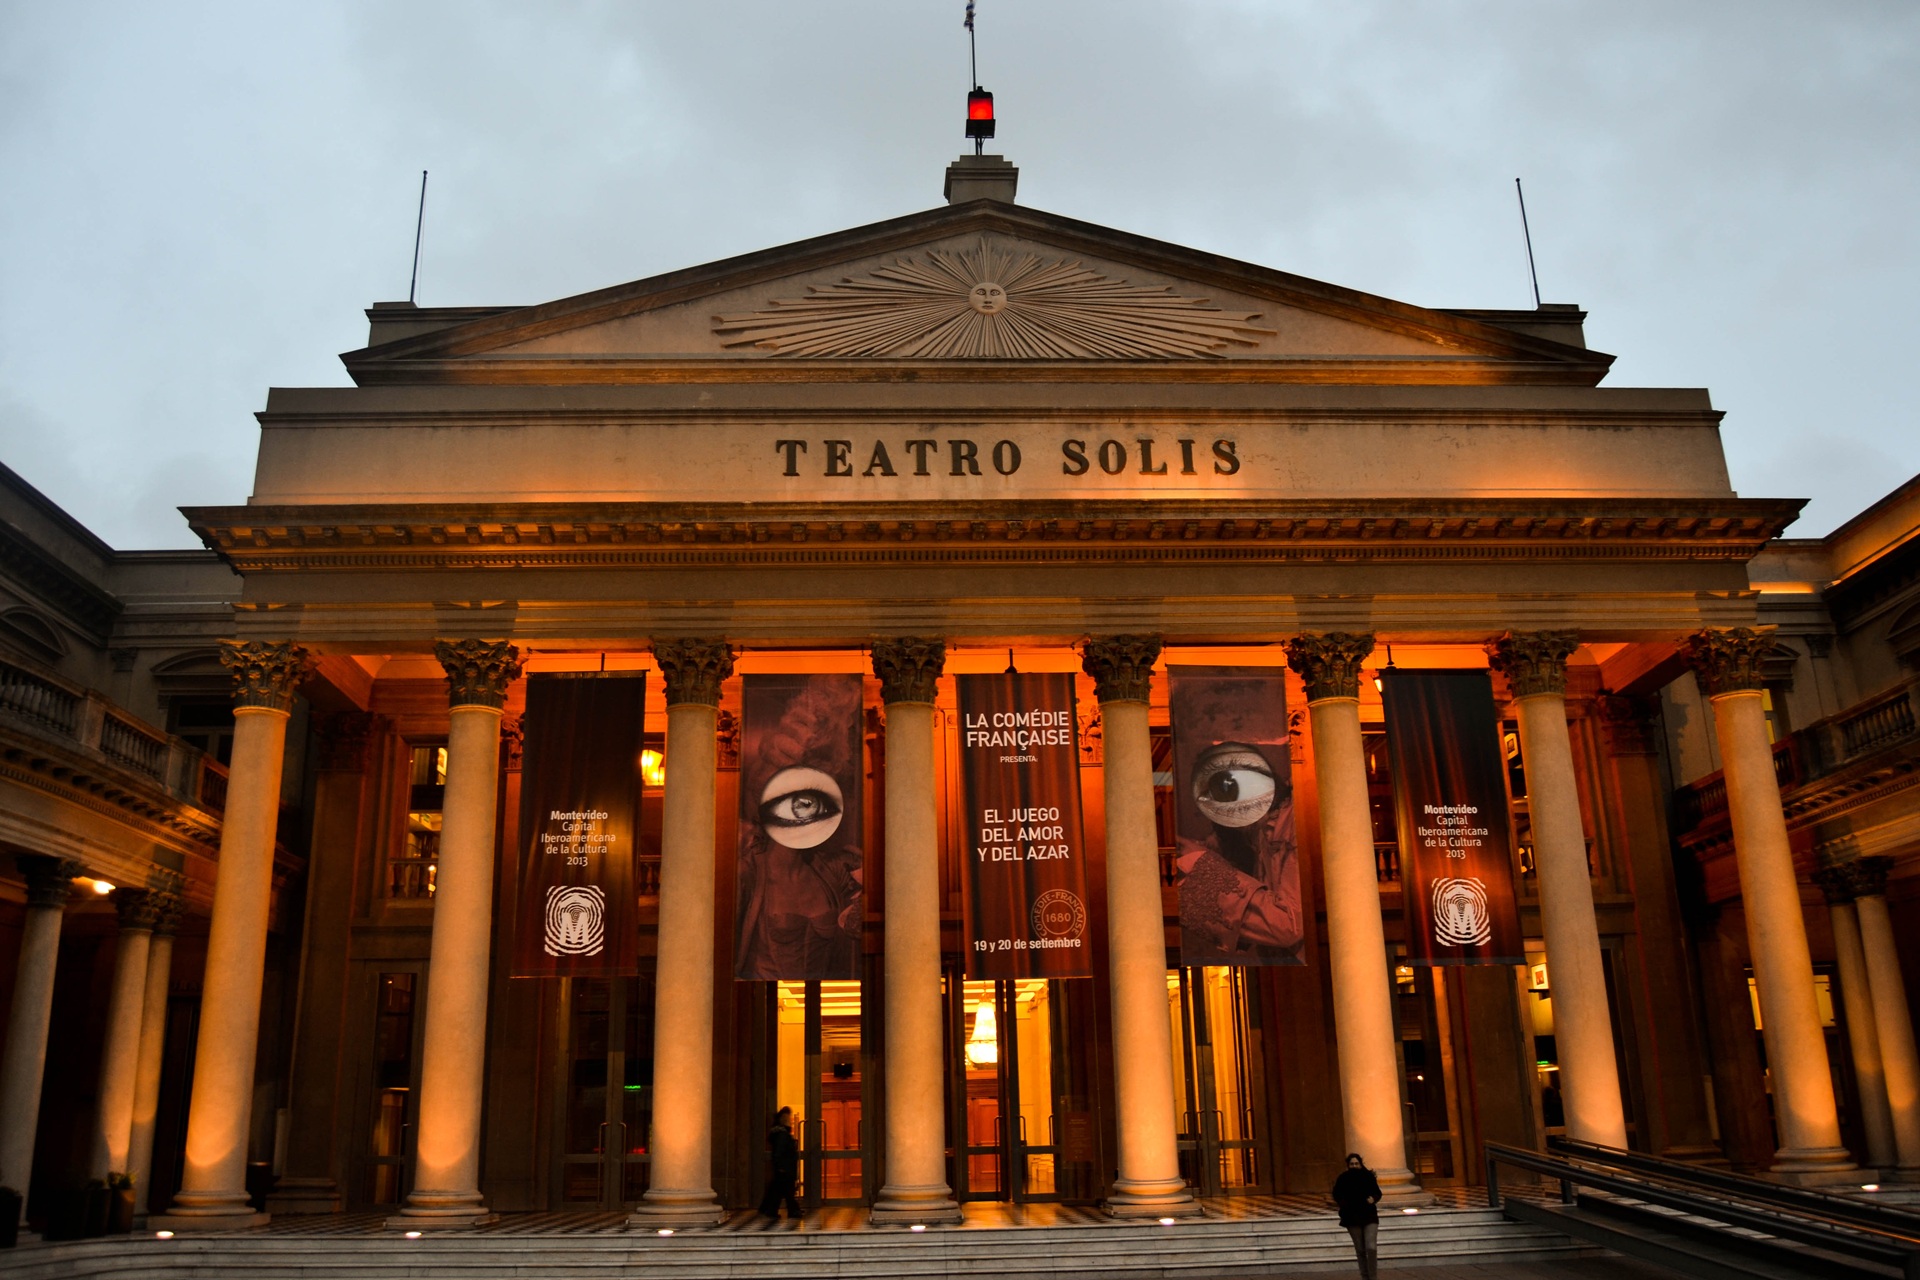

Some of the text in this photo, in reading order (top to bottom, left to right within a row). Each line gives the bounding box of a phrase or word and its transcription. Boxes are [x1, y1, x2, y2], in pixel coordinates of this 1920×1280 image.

[776, 439, 1241, 477] TEATRO SOLIS
[966, 709, 1070, 729] LA COMÉDIE
[966, 729, 1071, 751] FRANÇAISE
[550, 809, 609, 820] Montevideo
[1424, 804, 1478, 814] Montevideo
[984, 807, 1060, 824] EL JUEGO
[1436, 815, 1468, 827] Capital
[562, 821, 596, 833] Capital
[1418, 826, 1488, 836] Iberoamericana
[541, 832, 616, 843] Iberoamericana
[982, 826, 1064, 843] DEL AMOR
[1424, 837, 1482, 847] de la Cultura
[546, 843, 607, 854] de la Cultura
[977, 844, 1070, 862] Y DEL AZAR
[1445, 849, 1466, 860] 2013
[566, 856, 588, 867] 2013
[1045, 912, 1071, 923] 1680
[974, 937, 1082, 953] 19 y 20 de setiembre
